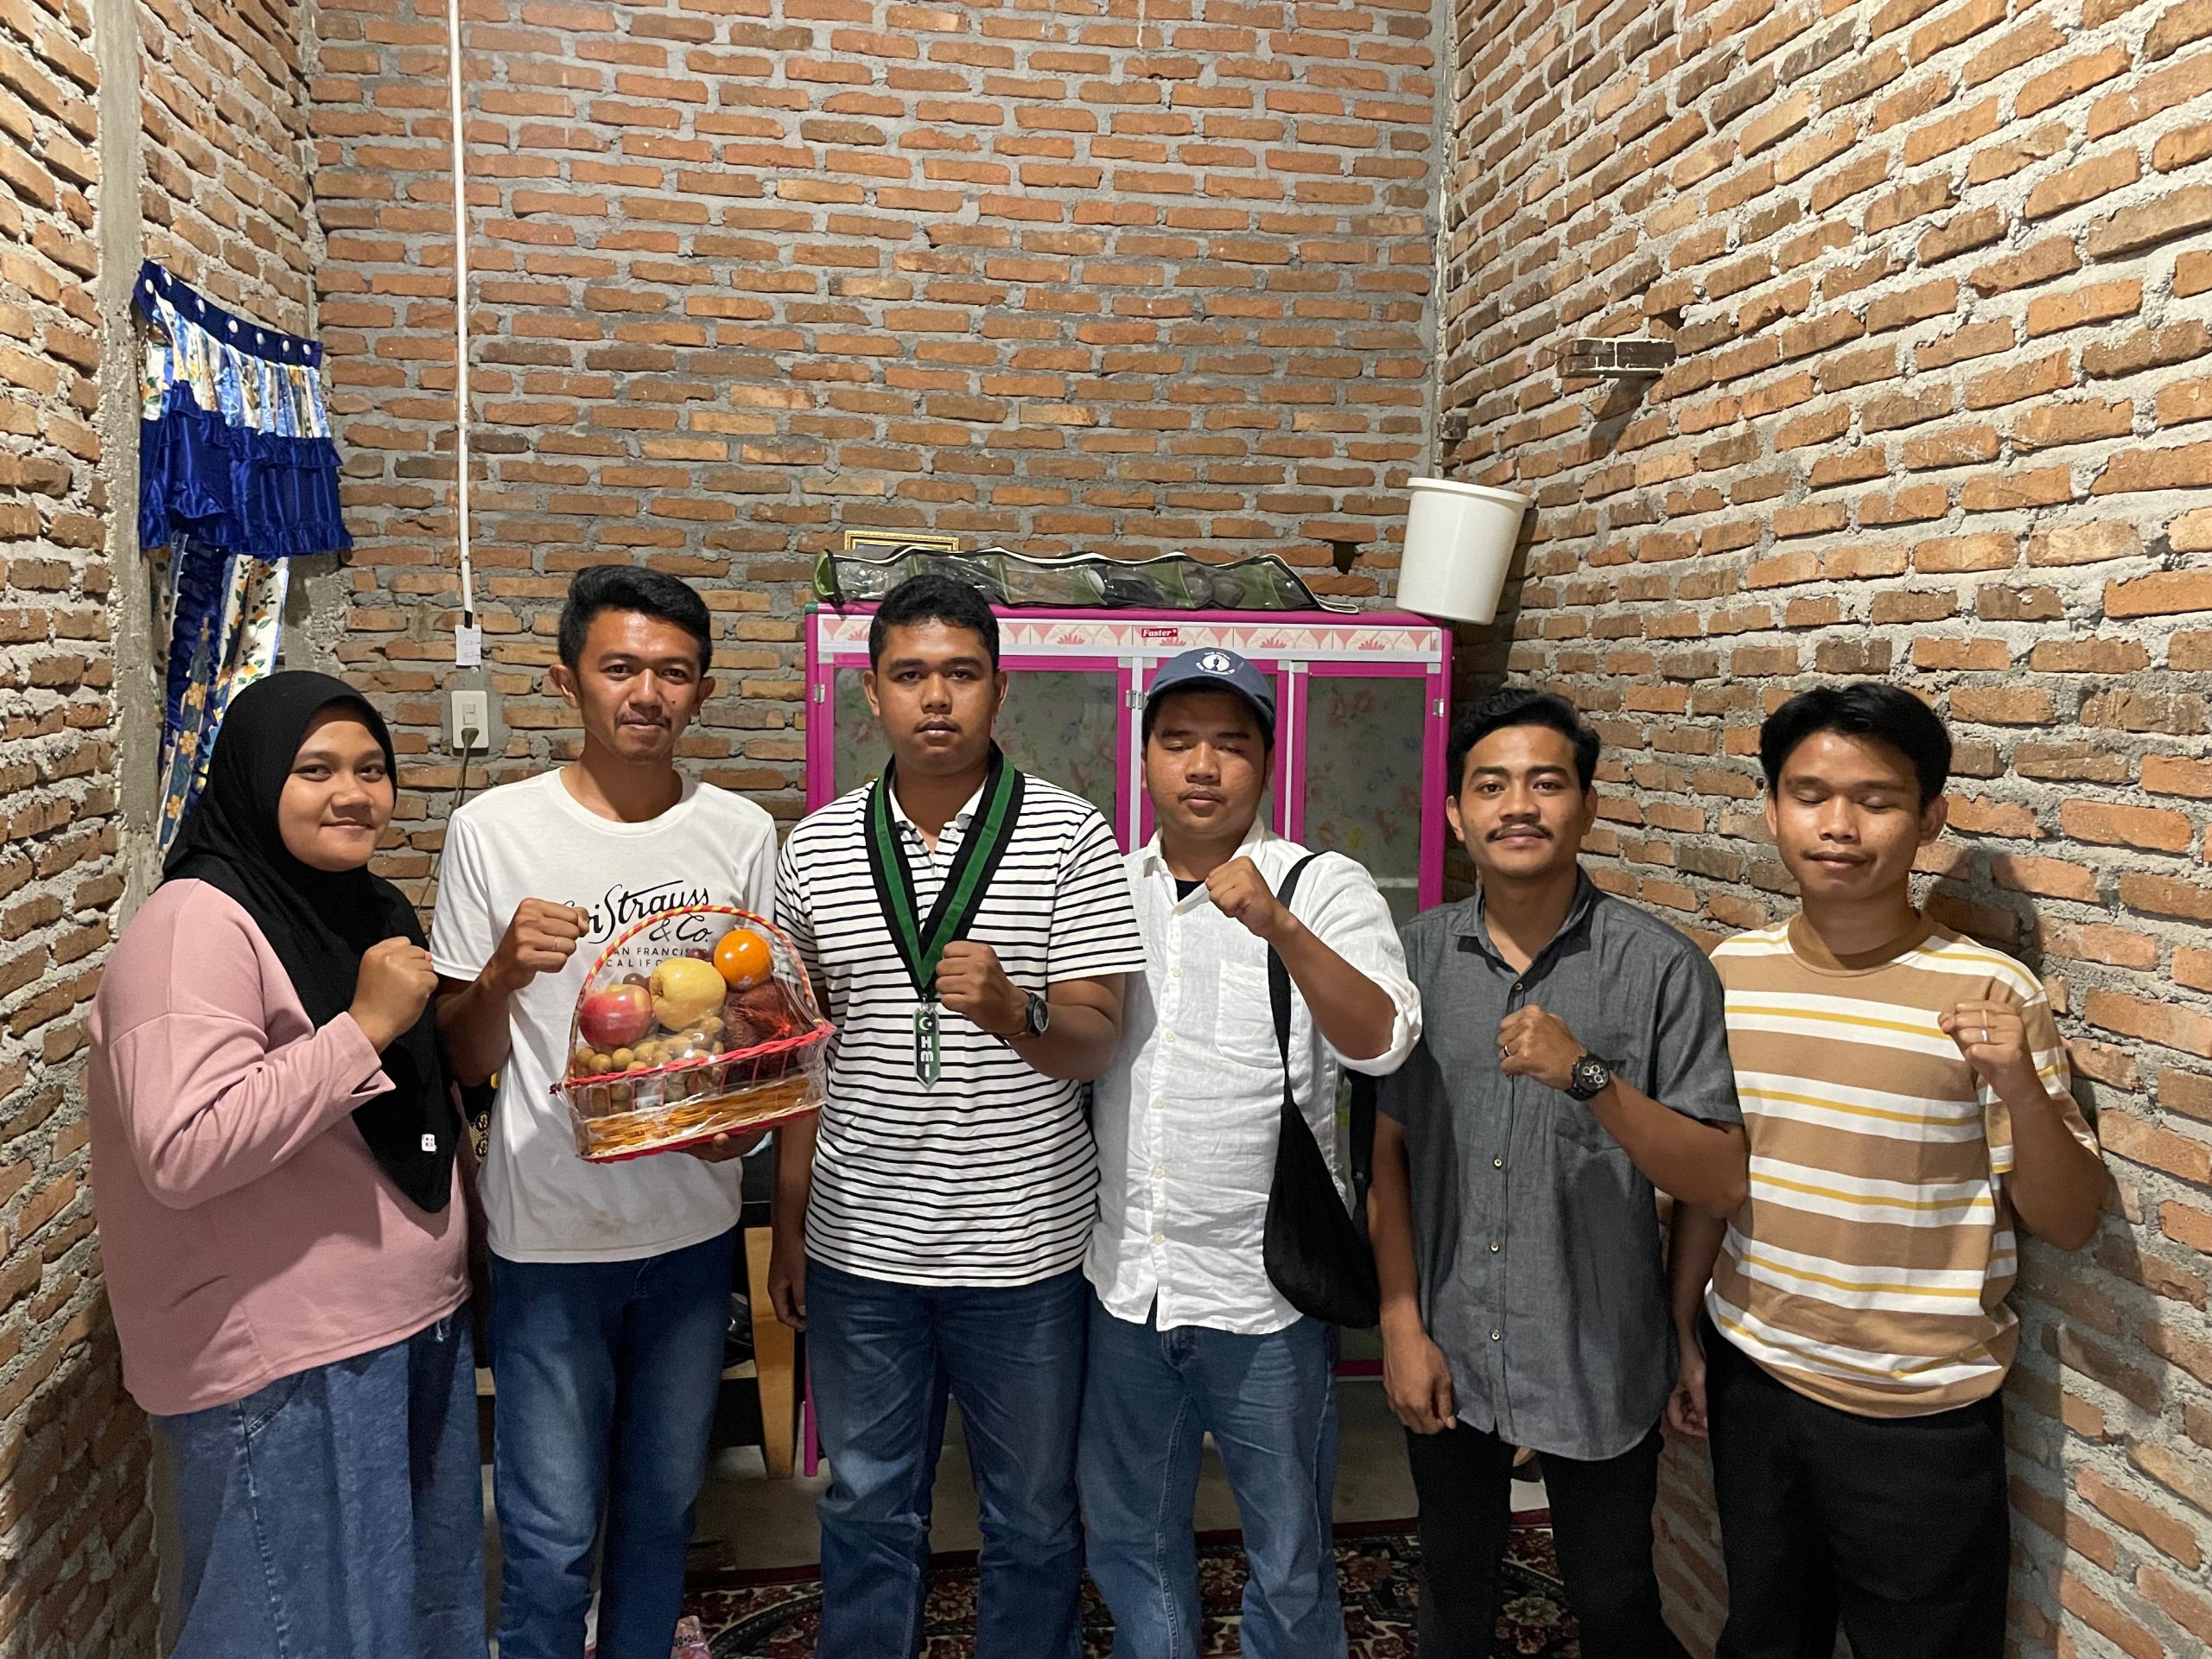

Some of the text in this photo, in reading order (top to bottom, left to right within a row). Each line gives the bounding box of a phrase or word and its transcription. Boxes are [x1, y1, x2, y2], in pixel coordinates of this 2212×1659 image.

[649, 912, 713, 943] & Co.
[637, 947, 708, 957] FRANCIS
